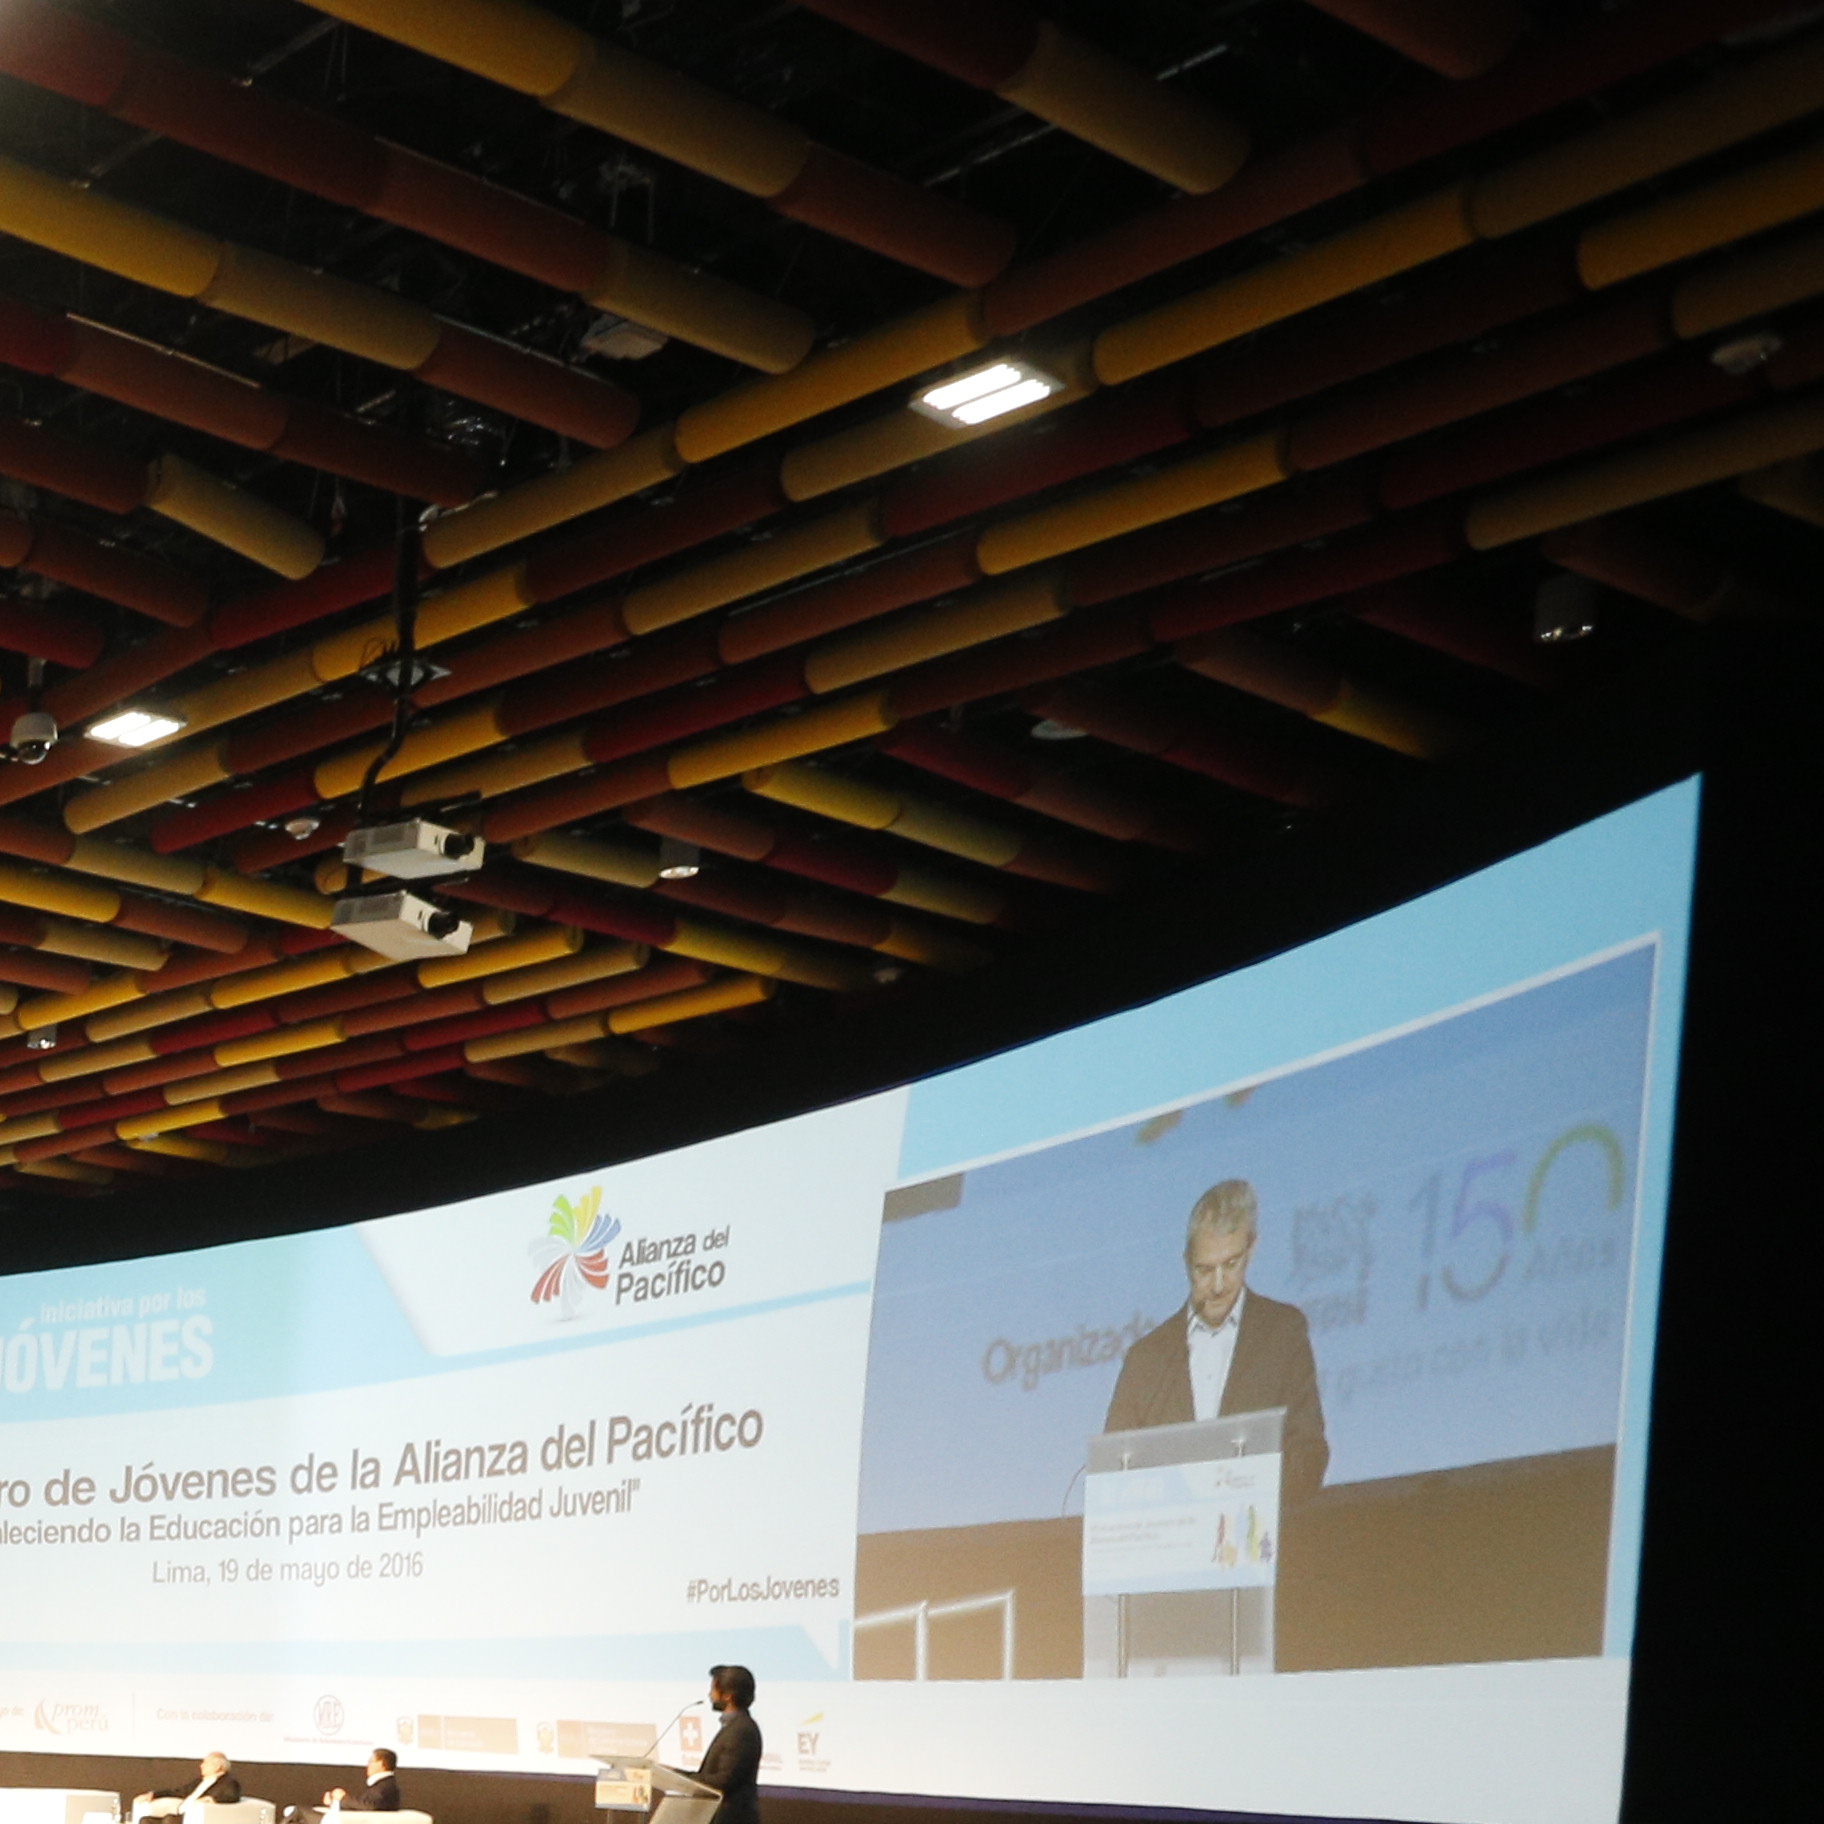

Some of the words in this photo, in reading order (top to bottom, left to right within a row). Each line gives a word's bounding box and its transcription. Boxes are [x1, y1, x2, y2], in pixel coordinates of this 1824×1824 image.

[618, 1233, 696, 1269] Alianza
[702, 1225, 731, 1251] del
[615, 1259, 726, 1306] Pacífico
[139, 1293, 170, 1319] por
[177, 1286, 207, 1308] los
[44, 1468, 96, 1507] de
[109, 1462, 277, 1504] Jóvenes
[289, 1452, 339, 1495] de
[350, 1448, 381, 1491] la
[392, 1438, 529, 1487] Alianza
[540, 1419, 597, 1473] del
[605, 1401, 765, 1465] Pacífico
[119, 1516, 141, 1543] la
[149, 1509, 281, 1543] Educación
[288, 1506, 343, 1545] para
[350, 1504, 371, 1534] la
[378, 1487, 543, 1540] Empleabilidad
[550, 1477, 641, 1519] Juvenil"
[152, 1559, 212, 1587] Lima,
[218, 1558, 239, 1583] 19
[245, 1557, 273, 1582] de
[279, 1558, 340, 1588] mayo
[347, 1553, 373, 1580] de
[379, 1551, 424, 1579] 2016
[686, 1575, 841, 1604] #PorLosJovenes
[51, 1700, 100, 1721] prom
[66, 1714, 109, 1735] perú
[797, 1732, 820, 1755] EY
